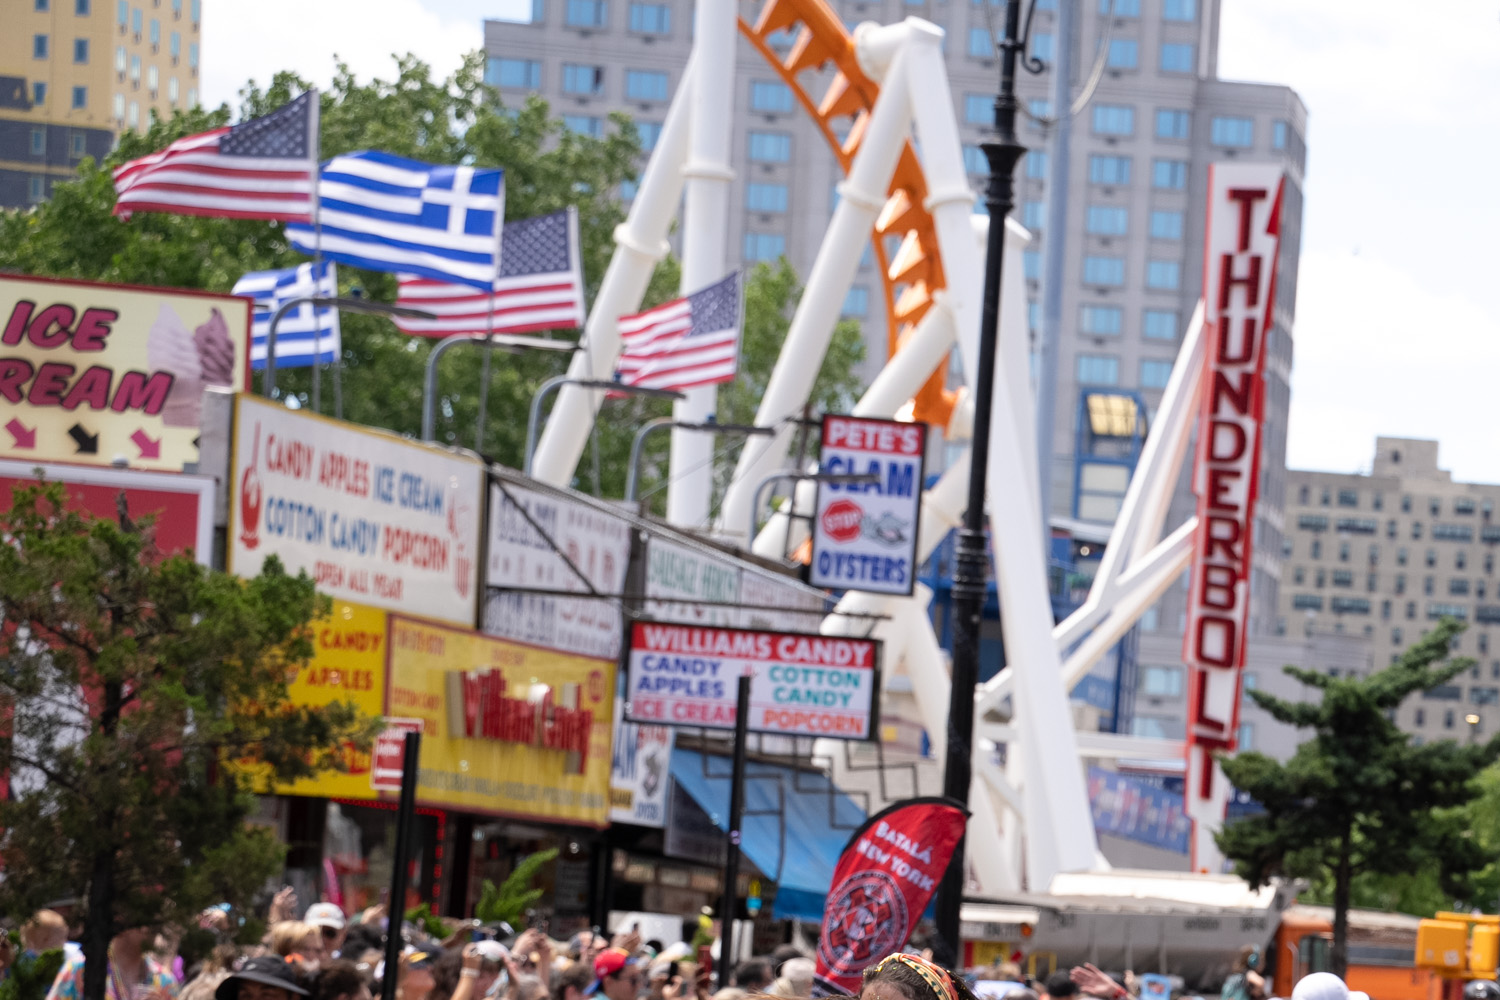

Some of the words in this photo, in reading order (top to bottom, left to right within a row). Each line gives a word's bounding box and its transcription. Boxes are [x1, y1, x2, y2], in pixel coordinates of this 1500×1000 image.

[1, 299, 120, 352] ICE
[828, 419, 919, 454] PETE'S
[265, 434, 316, 481] CANDY
[317, 452, 371, 499] APPLES
[373, 464, 396, 503] ICE
[399, 470, 447, 517] CREAM
[826, 455, 914, 498] CLAM
[1195, 188, 1268, 800] THUNDERBOLT
[265, 497, 326, 545] COTTON
[329, 511, 381, 558] CANDY
[382, 525, 448, 572] POPCORN
[315, 560, 344, 588] OPEN
[347, 569, 368, 594] ALL
[373, 573, 405, 601] YEAR
[818, 550, 906, 584] OYSTERS
[320, 628, 383, 653] CANDY
[642, 624, 772, 659] WILLIAMS
[777, 639, 872, 667] CANDY
[306, 666, 374, 691] APPLES
[641, 655, 723, 678] CANDY
[768, 665, 861, 689] COTTON
[637, 676, 726, 699] APPLES
[773, 686, 854, 708] CANDY
[632, 699, 665, 720] ICE
[763, 709, 864, 735] POPCORN
[875, 821, 934, 865] BATALÁ
[857, 838, 891, 865] NEW
[890, 855, 935, 891] YORK
